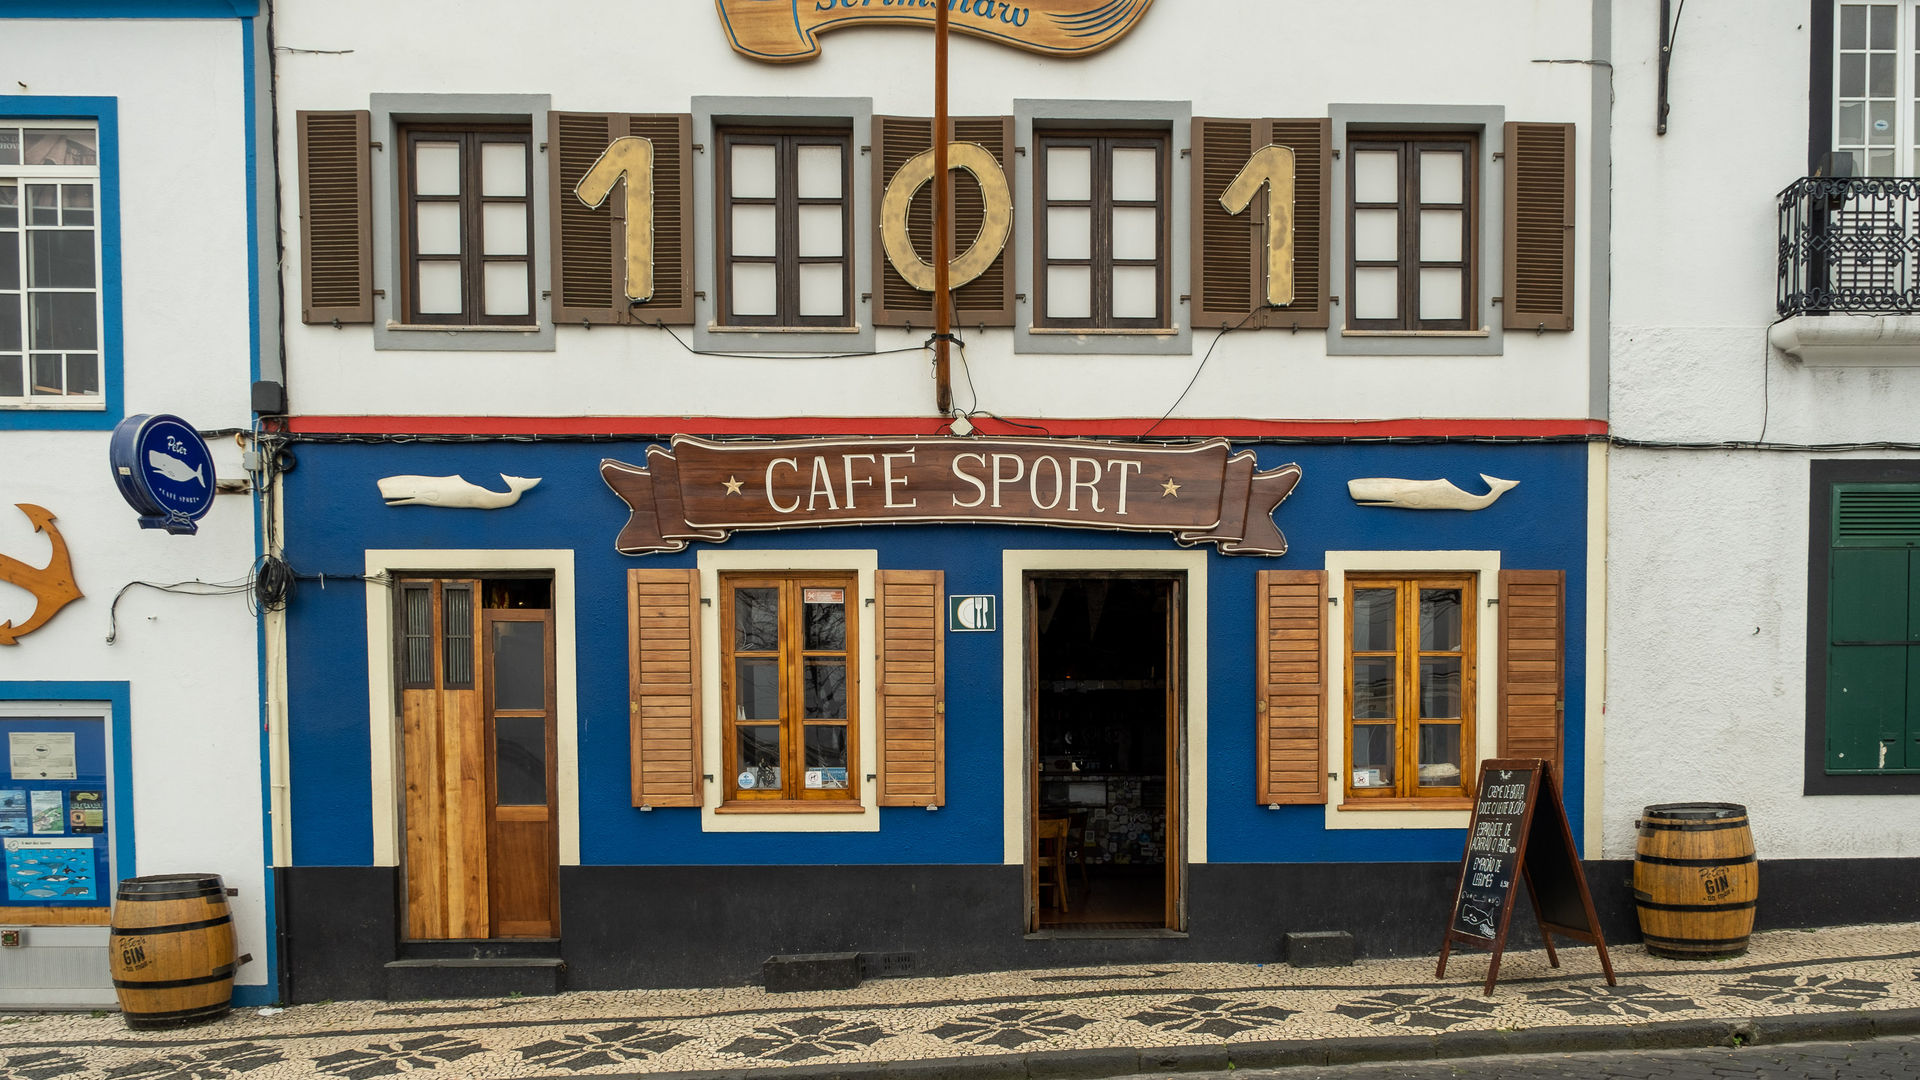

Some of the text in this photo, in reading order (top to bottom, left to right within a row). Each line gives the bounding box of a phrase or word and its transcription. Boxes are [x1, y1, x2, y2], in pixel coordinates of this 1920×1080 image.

[166, 435, 187, 456] Peter
[765, 446, 1142, 515] CAFÉ SPORT
[1705, 875, 1728, 894] GIN
[123, 946, 145, 965] GIN
